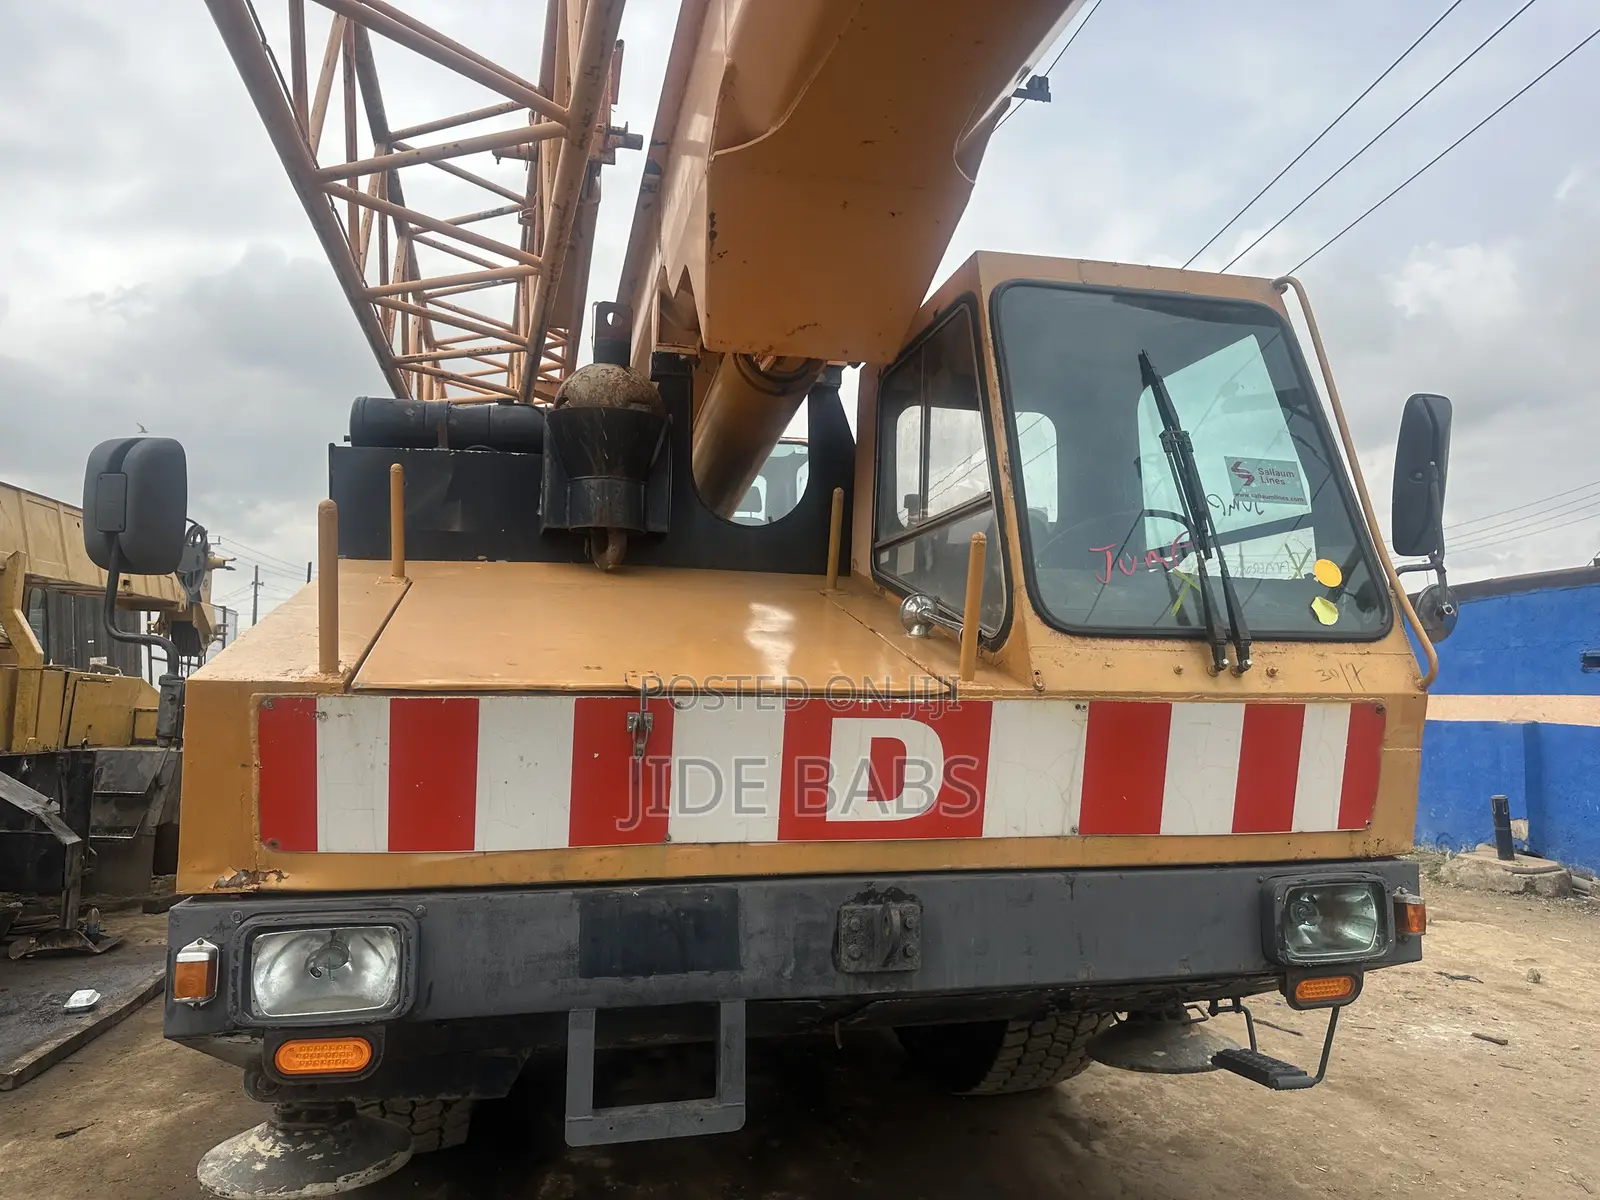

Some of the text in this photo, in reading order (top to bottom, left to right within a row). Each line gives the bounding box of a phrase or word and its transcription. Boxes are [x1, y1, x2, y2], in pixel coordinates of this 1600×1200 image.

[1258, 467, 1295, 478] Sallaum
[1260, 475, 1286, 485] Lines
[825, 717, 945, 822] D
